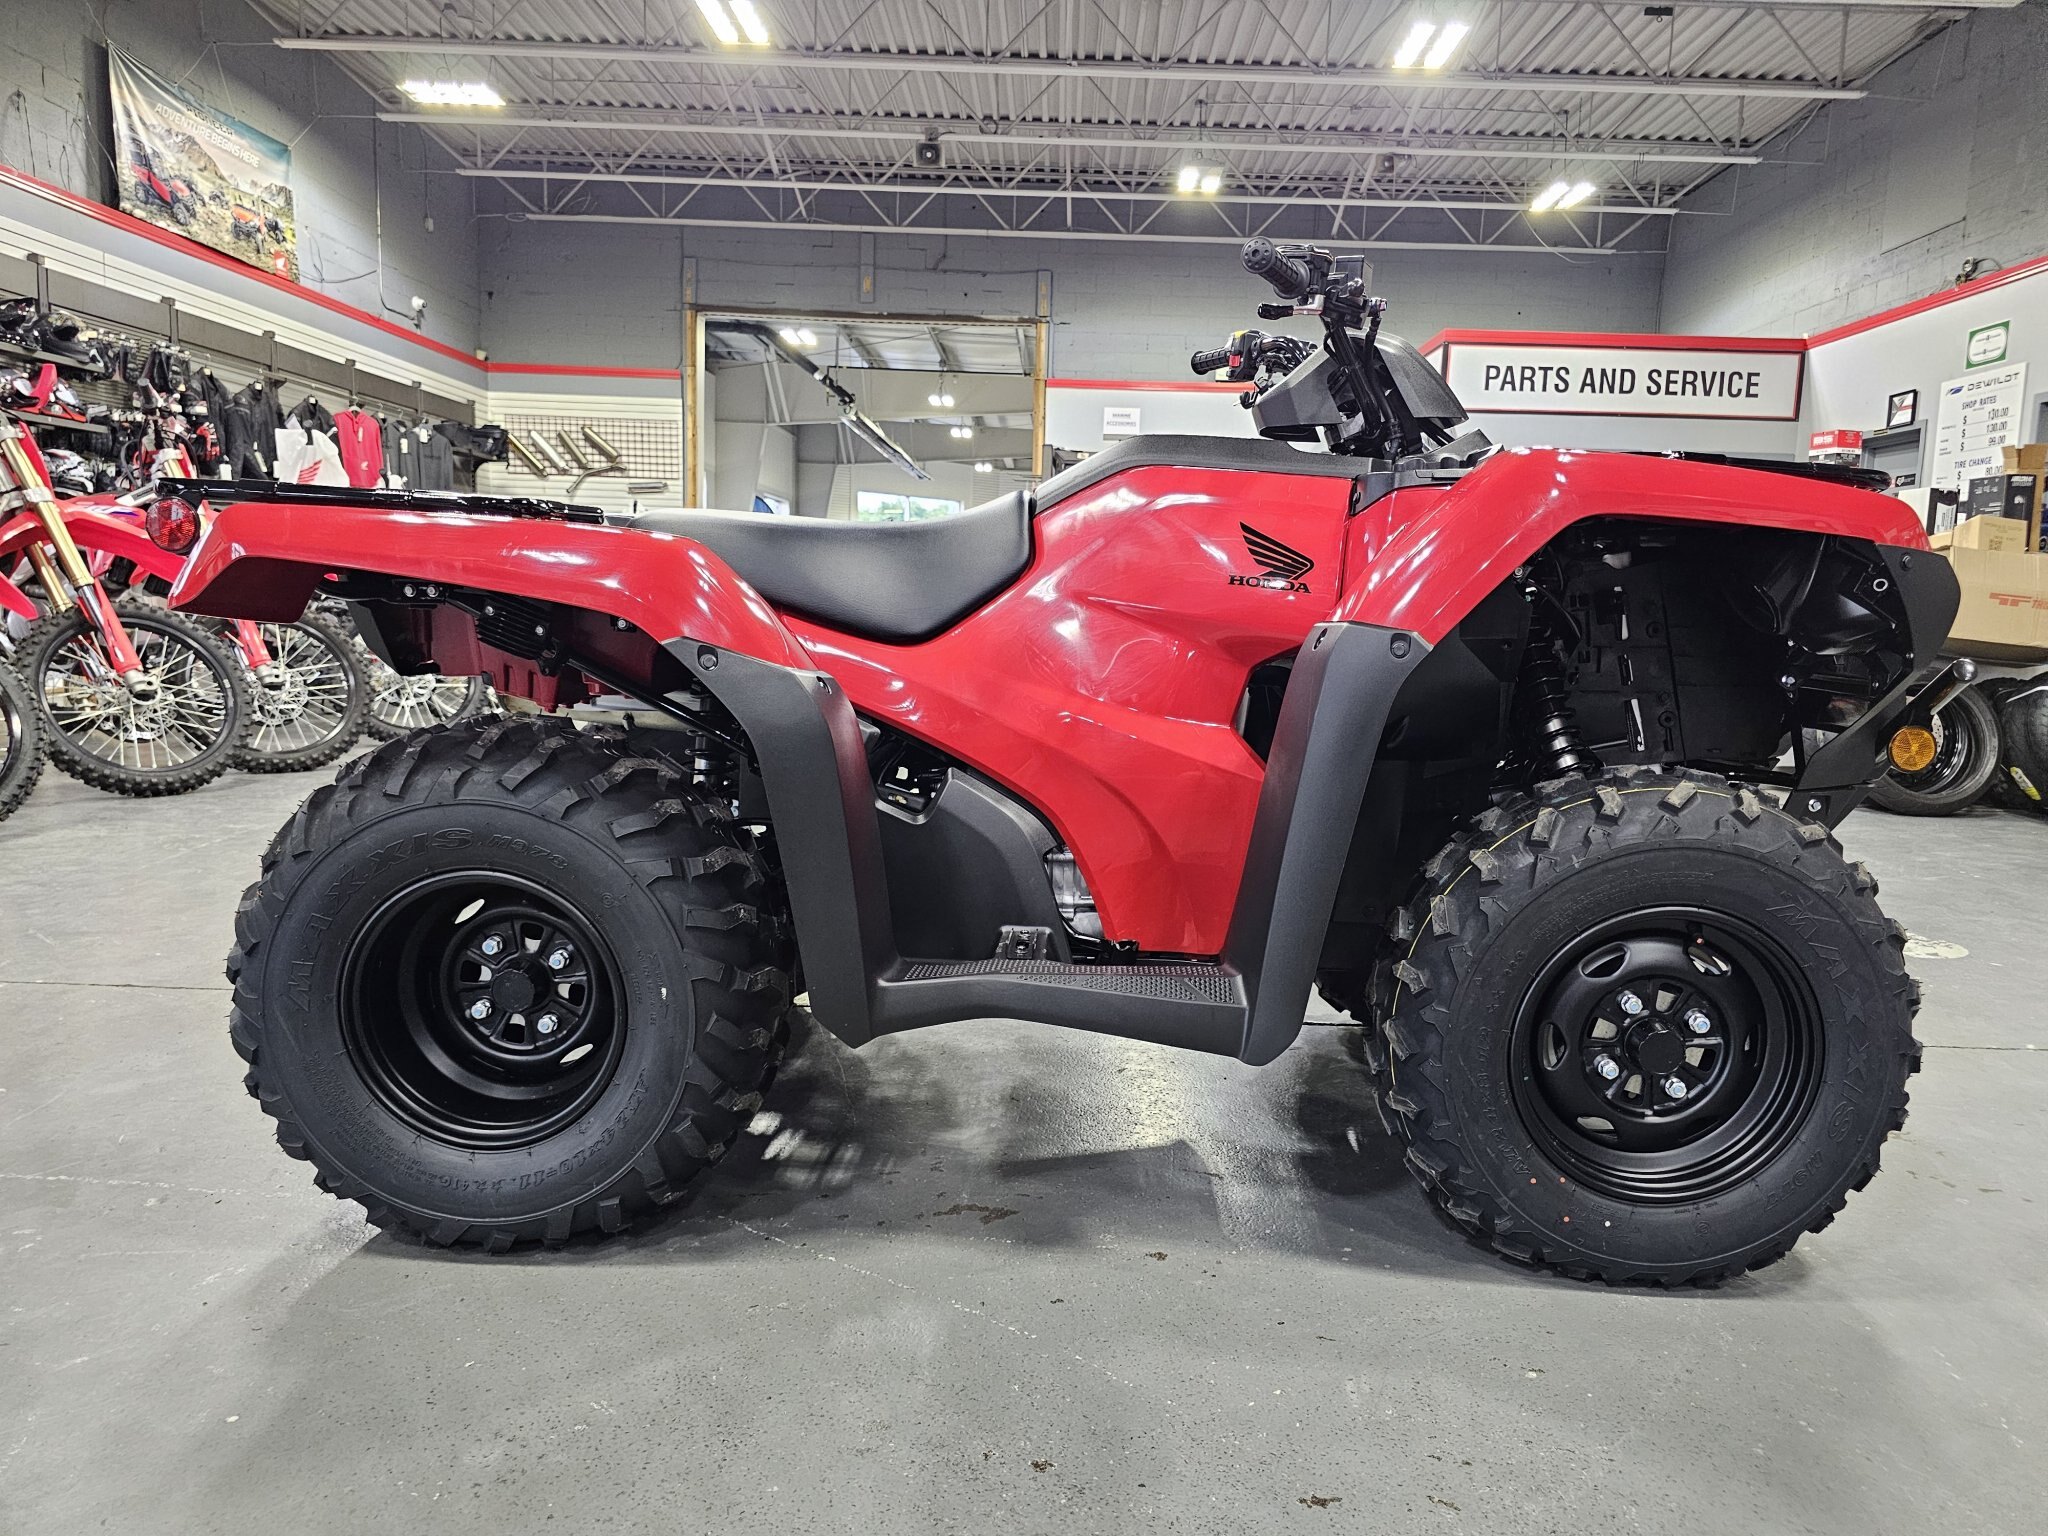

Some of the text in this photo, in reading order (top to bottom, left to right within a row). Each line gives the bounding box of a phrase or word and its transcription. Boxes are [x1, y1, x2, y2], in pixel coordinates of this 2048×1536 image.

[154, 103, 260, 168] ADVENTURE BEGINS HERE
[1484, 365, 1761, 398] PARTS AND SERVICE
[1961, 399, 1978, 411] SHOP
[1979, 395, 1997, 407] RATES
[1954, 456, 1993, 469] TIRE CHANGE
[287, 827, 474, 1012] MAXXIS
[1765, 903, 1871, 1143] MAXXIS
